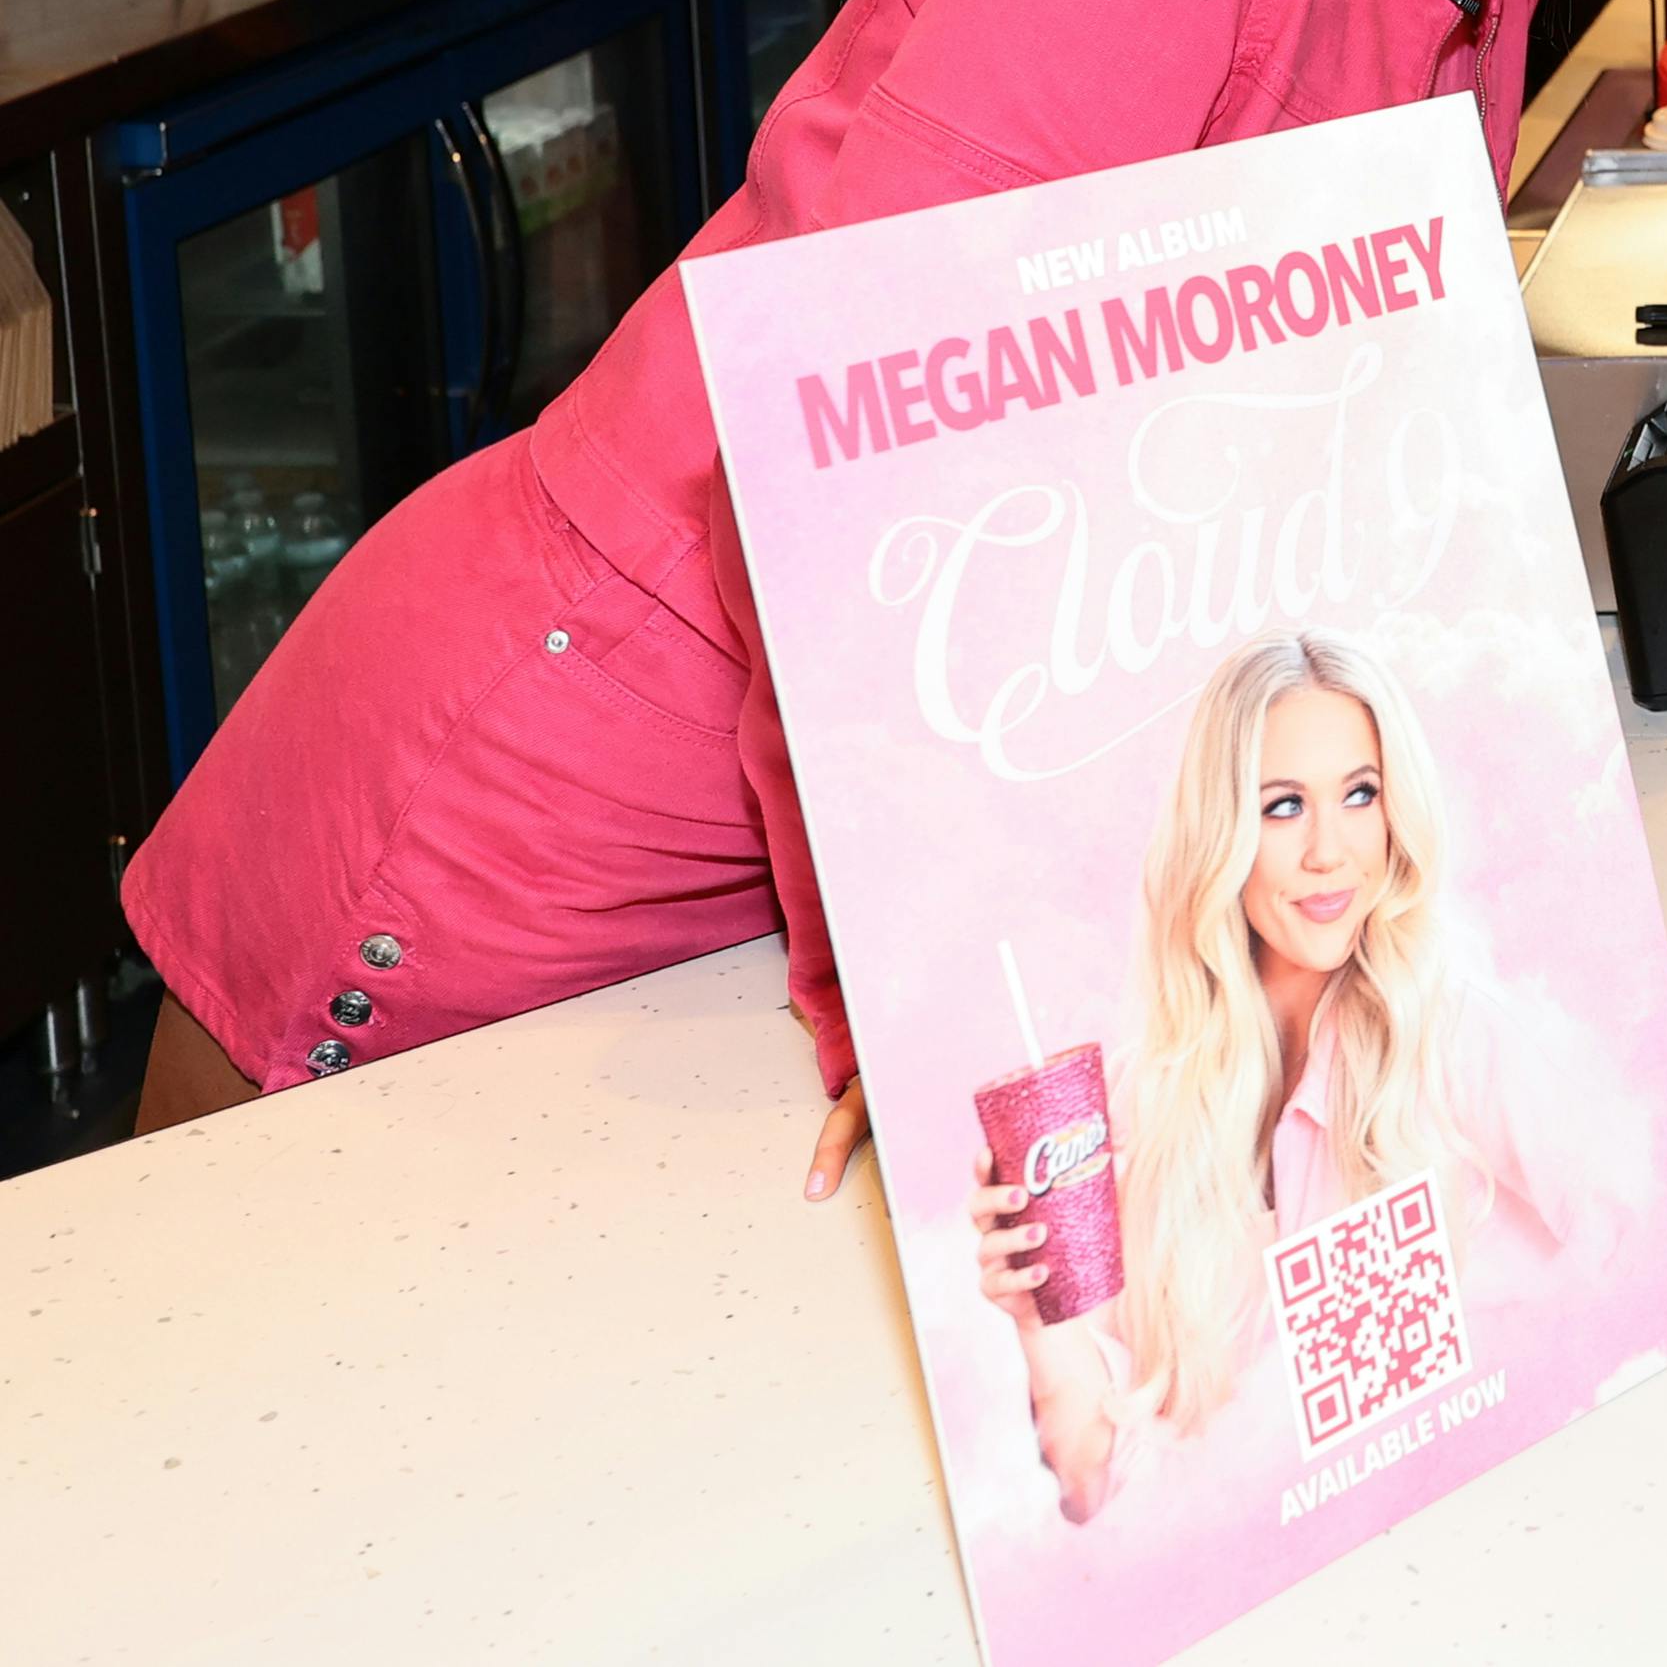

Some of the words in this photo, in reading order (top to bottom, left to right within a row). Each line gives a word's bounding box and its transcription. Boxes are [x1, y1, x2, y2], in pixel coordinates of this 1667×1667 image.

[794, 309, 1097, 470] MEGAN
[1103, 215, 1450, 388] MORONEY
[1016, 237, 1105, 296] NEW
[1117, 205, 1249, 272] ALBUM
[867, 341, 1384, 783] Cloud
[1280, 1409, 1436, 1526] AVAILABLE
[1438, 1368, 1508, 1434] NOW
